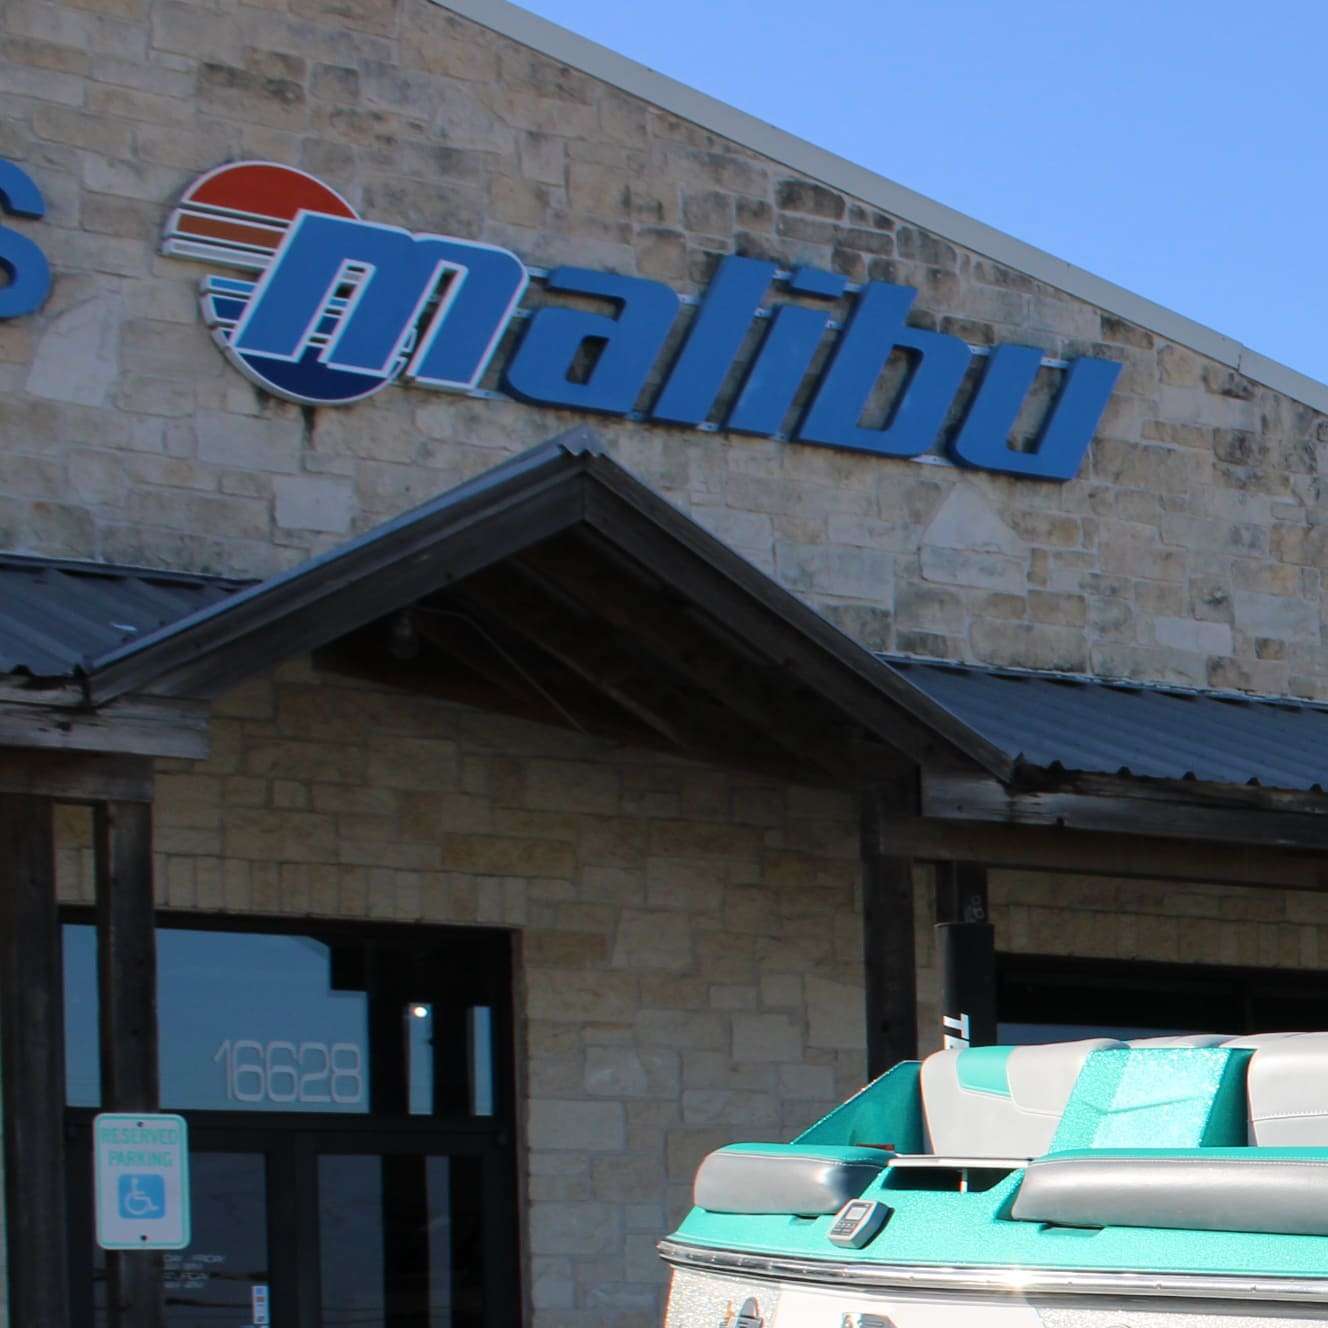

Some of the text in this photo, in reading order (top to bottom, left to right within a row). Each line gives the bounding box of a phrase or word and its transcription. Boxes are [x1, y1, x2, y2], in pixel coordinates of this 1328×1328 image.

[213, 1039, 364, 1103] 16628
[101, 1128, 178, 1145] RESERVED
[107, 1151, 174, 1168] PARKING
